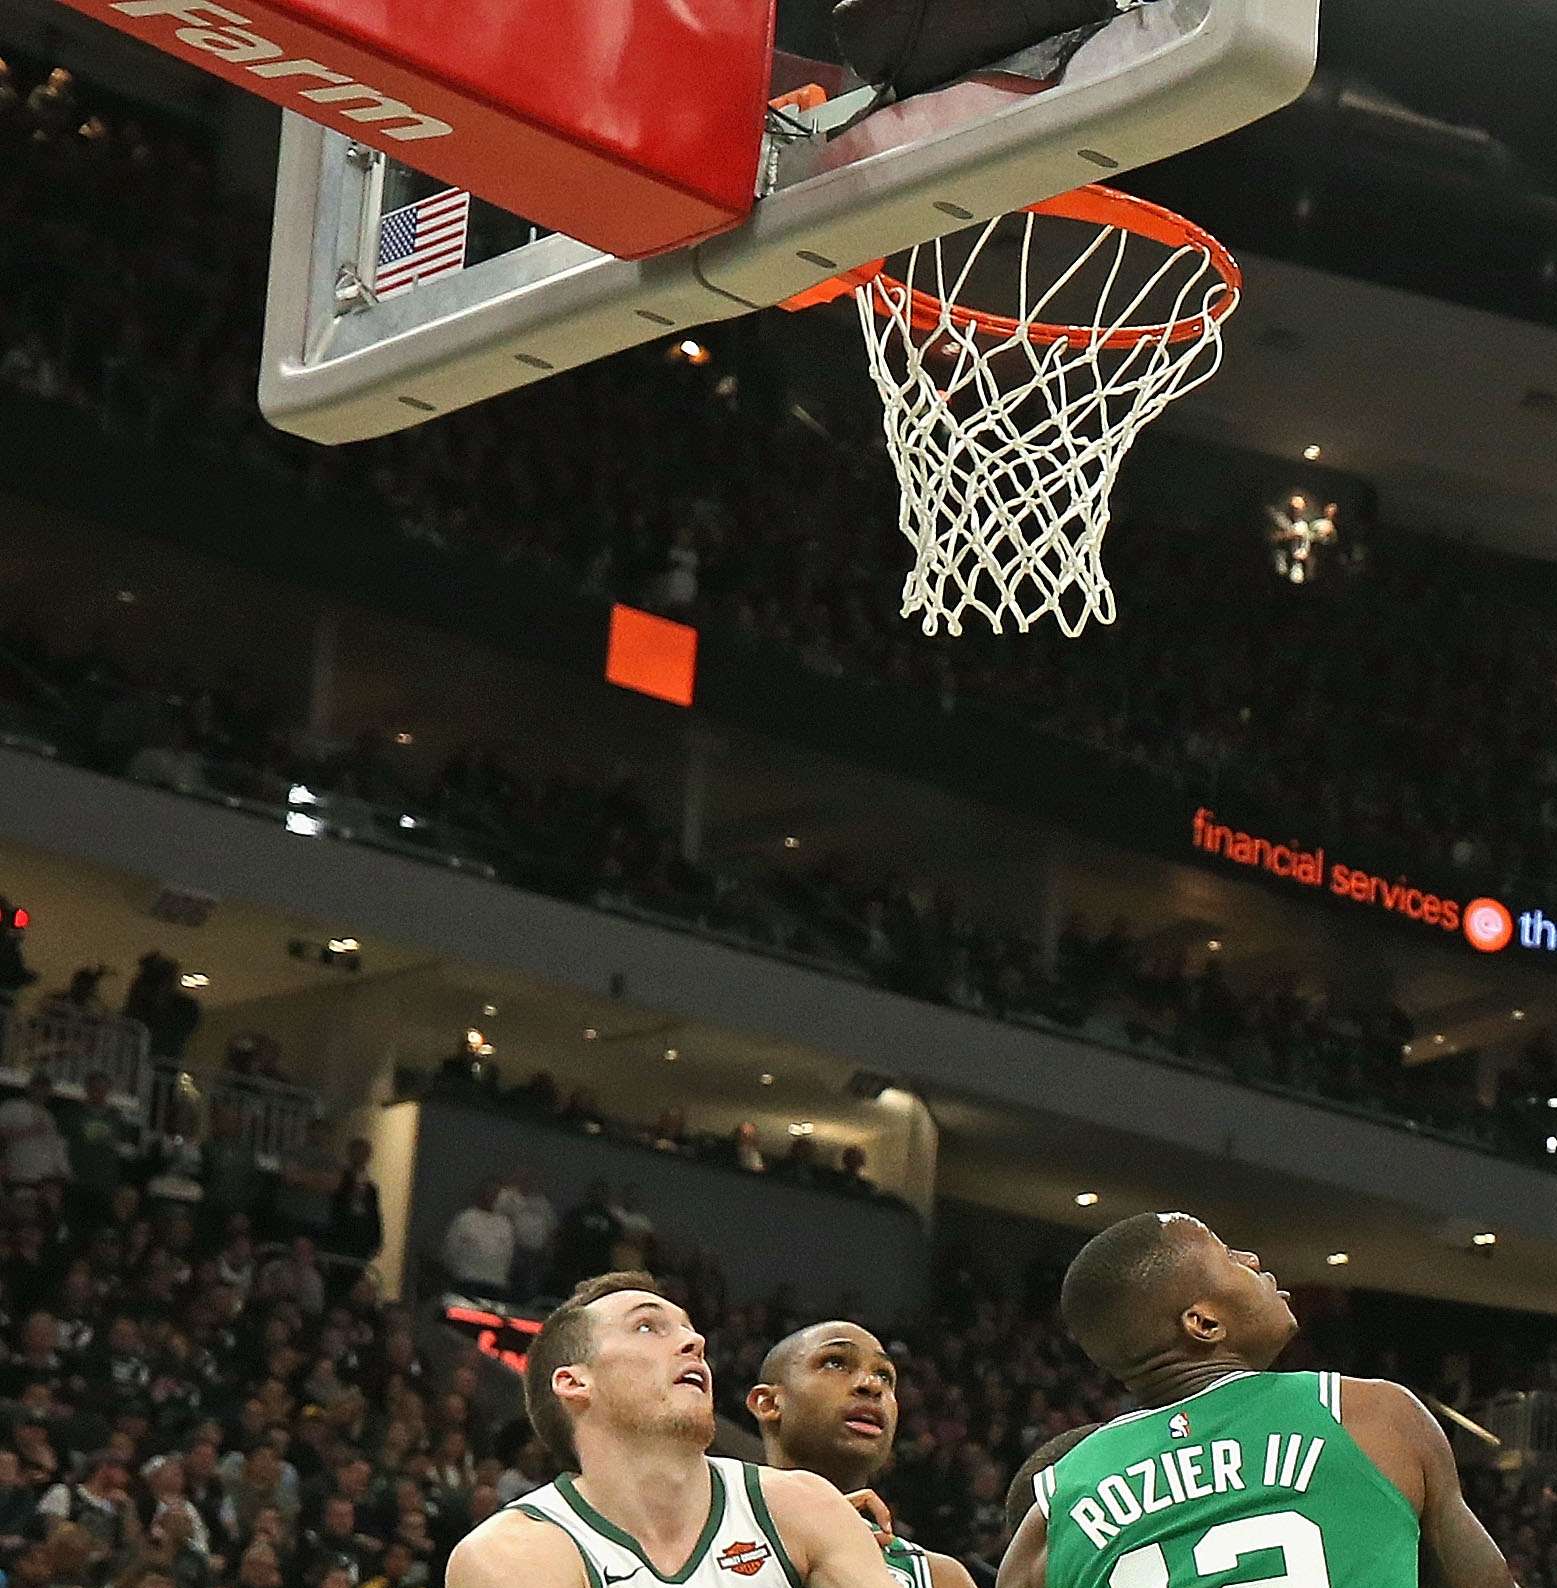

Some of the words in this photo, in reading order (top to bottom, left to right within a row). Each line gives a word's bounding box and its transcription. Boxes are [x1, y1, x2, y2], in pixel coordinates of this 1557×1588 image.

[110, 0, 454, 141] Farm
[1192, 807, 1324, 886] financial
[1331, 861, 1460, 931] services
[1069, 1438, 1247, 1551] ROZIER
[1262, 1433, 1326, 1494] III
